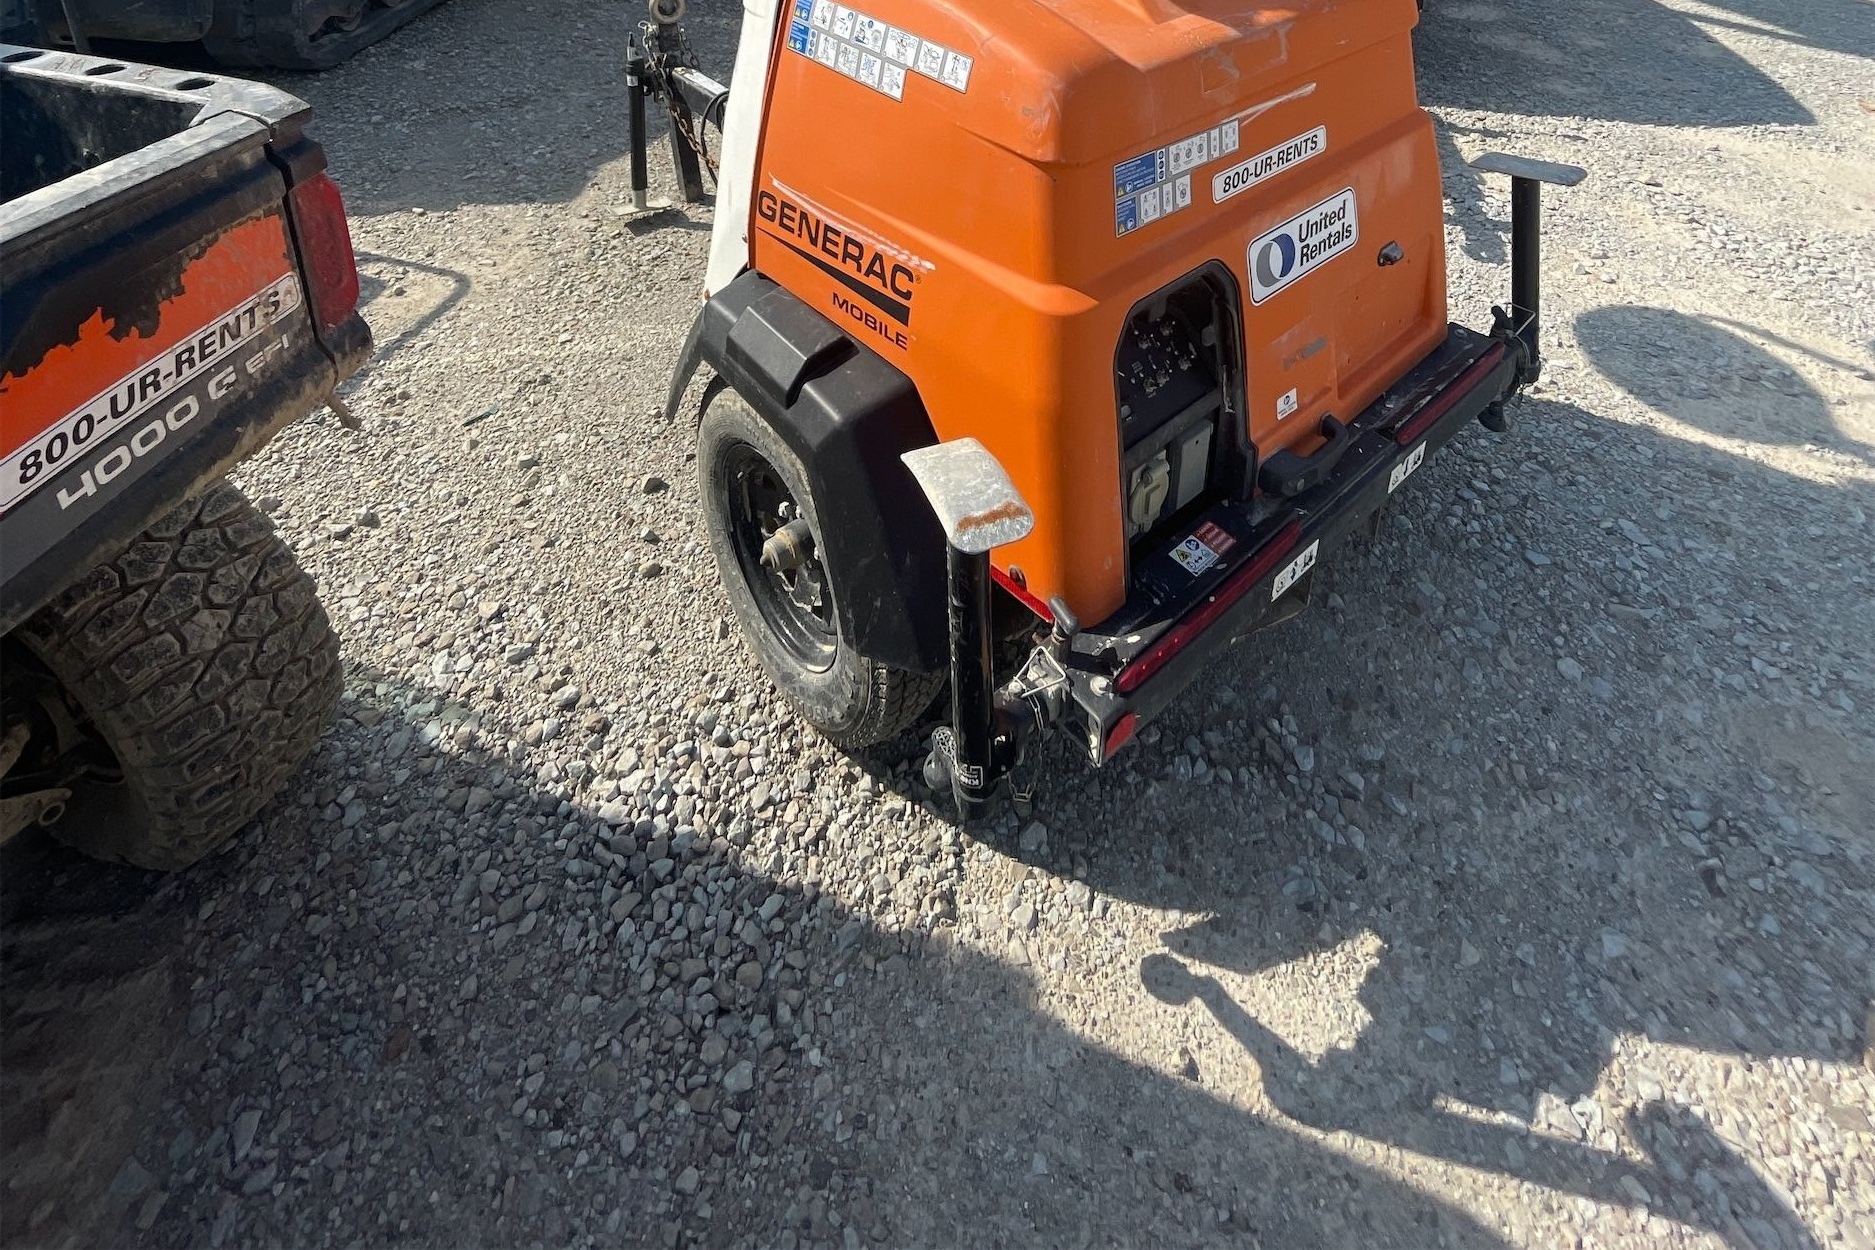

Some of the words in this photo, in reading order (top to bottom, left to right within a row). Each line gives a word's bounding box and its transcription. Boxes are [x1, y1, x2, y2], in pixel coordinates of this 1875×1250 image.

[1222, 133, 1318, 194] 800-UR-RENTS
[758, 190, 914, 301] GENERAC
[1298, 198, 1347, 244] United
[1299, 222, 1353, 268] Rentals
[832, 291, 908, 351] MOBILE
[18, 290, 281, 485] 800-UR-RENTS
[55, 394, 200, 511] 4000
